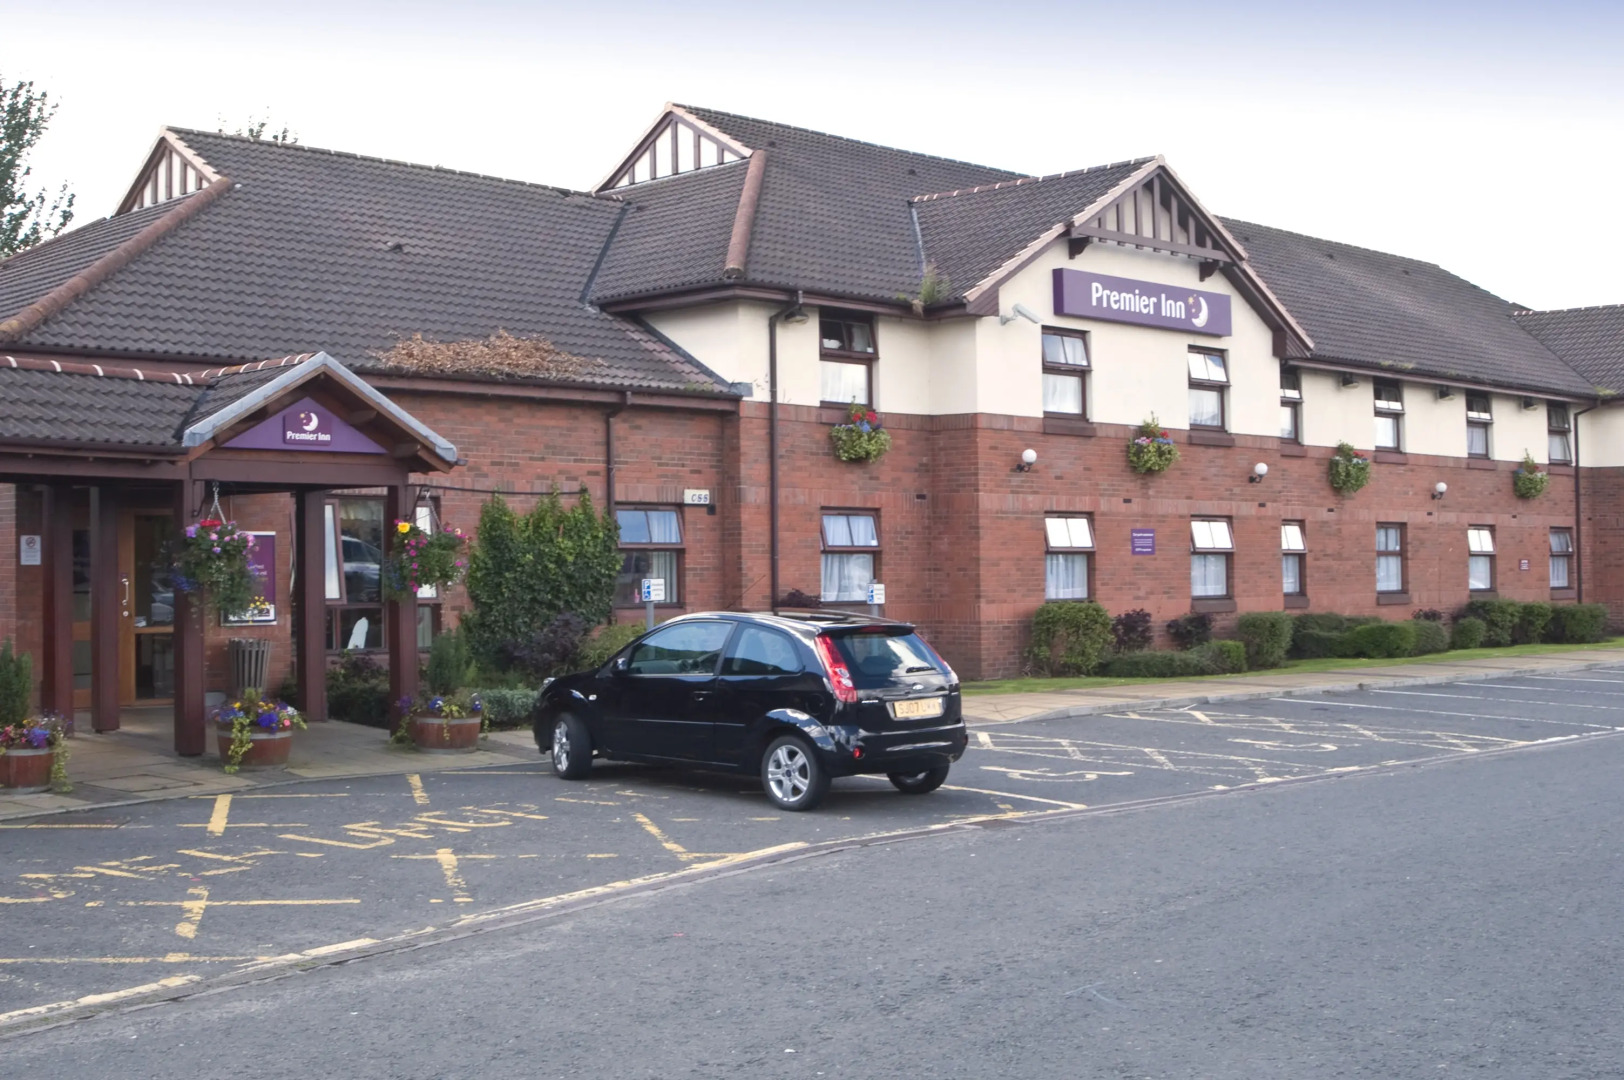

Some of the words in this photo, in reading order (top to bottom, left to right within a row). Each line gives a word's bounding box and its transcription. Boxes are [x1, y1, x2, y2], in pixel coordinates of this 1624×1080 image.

[1091, 282, 1157, 315] Premier
[1161, 293, 1185, 319] Inn
[287, 431, 317, 440] Premier
[318, 432, 331, 440] Inn
